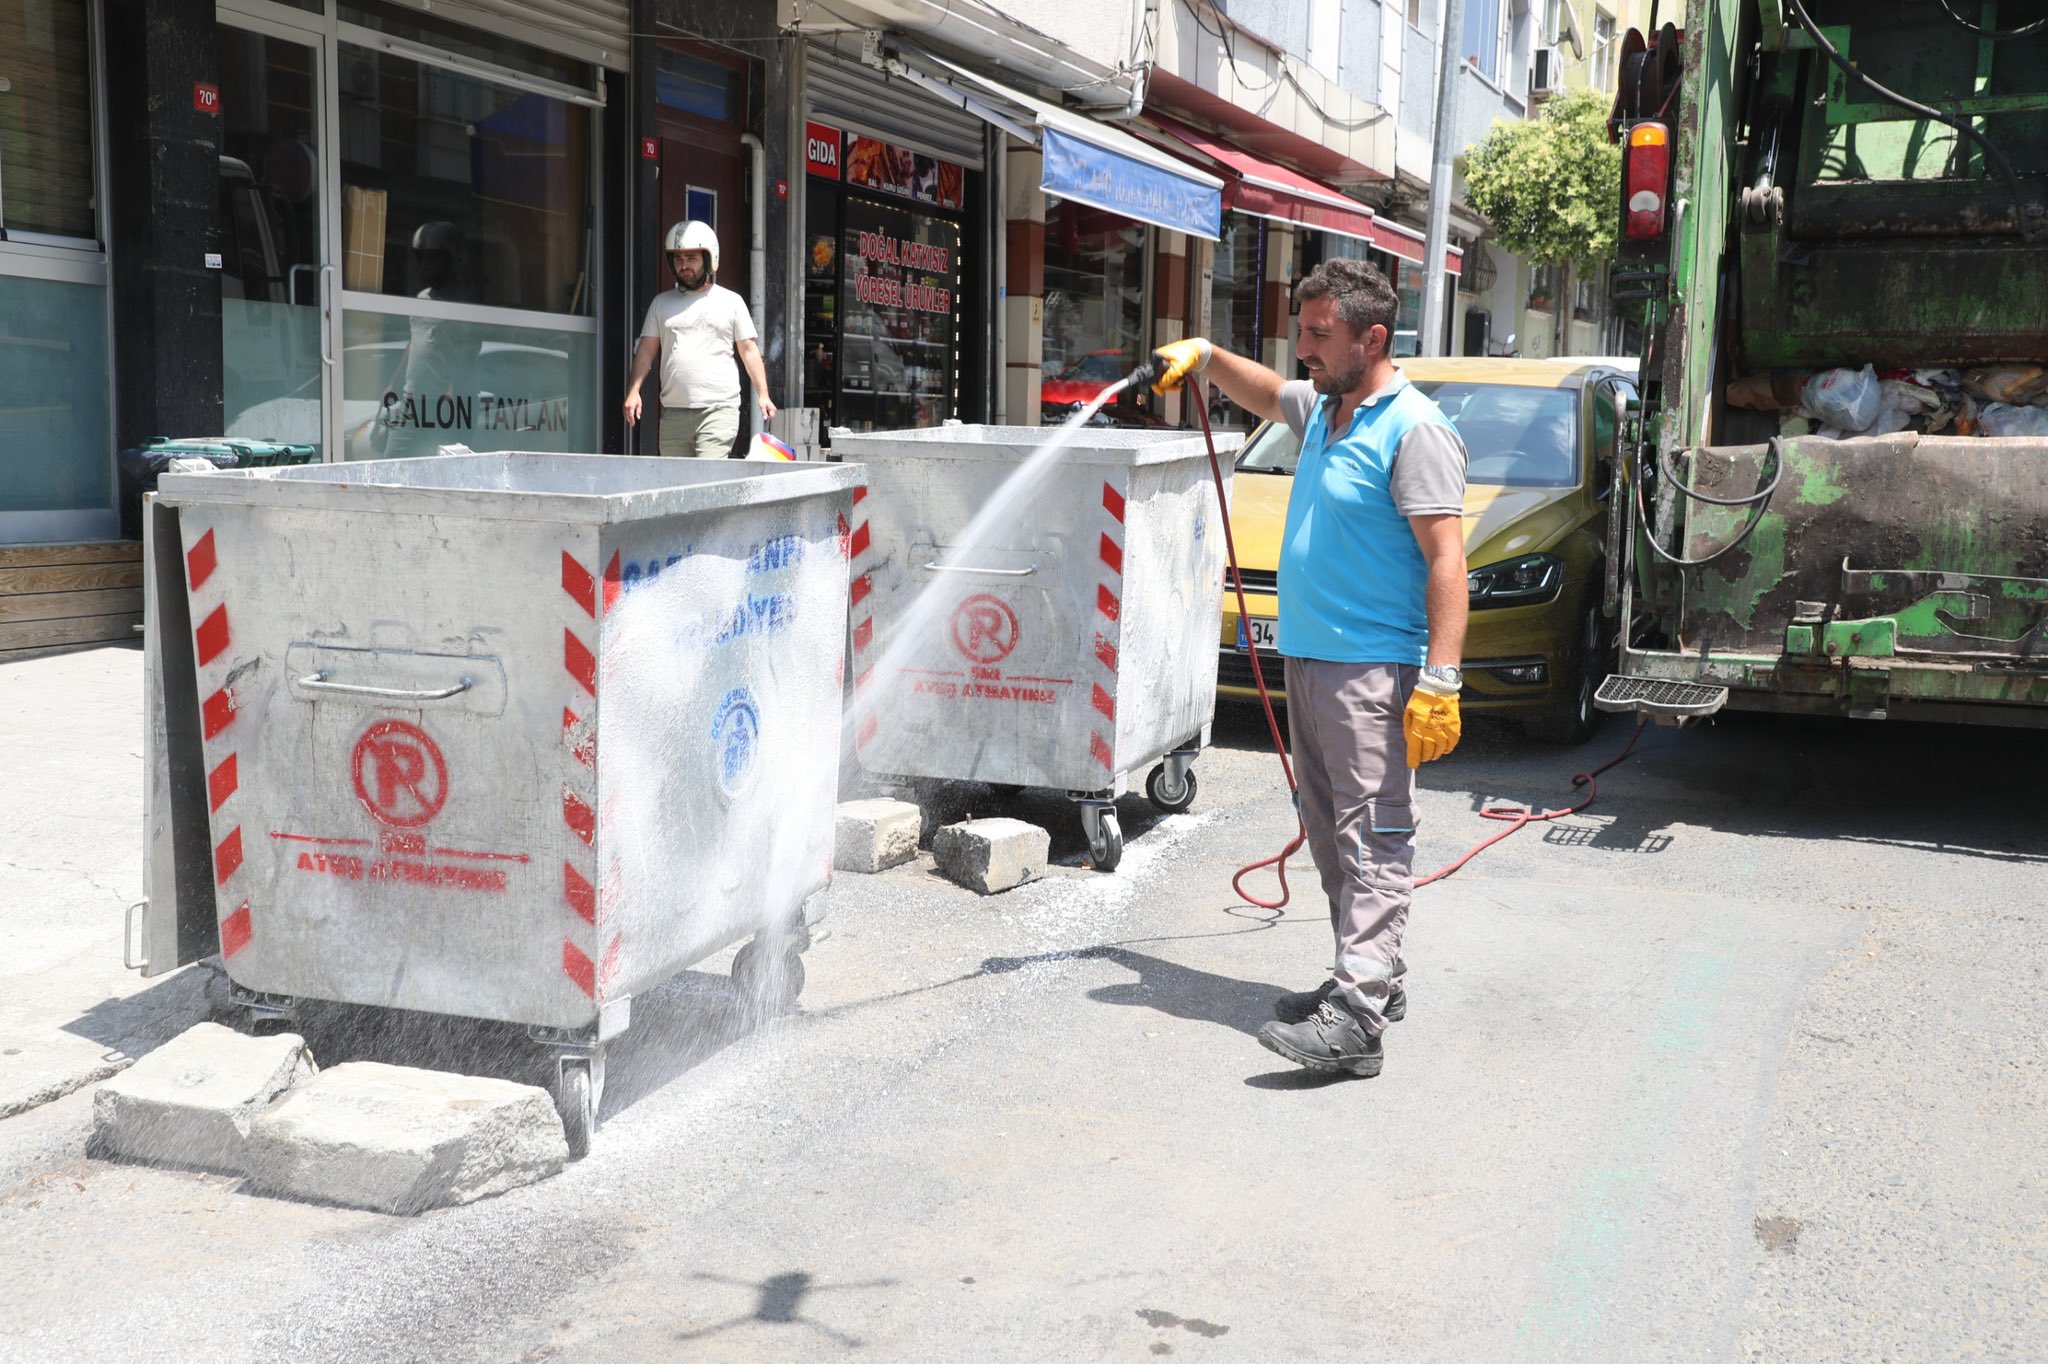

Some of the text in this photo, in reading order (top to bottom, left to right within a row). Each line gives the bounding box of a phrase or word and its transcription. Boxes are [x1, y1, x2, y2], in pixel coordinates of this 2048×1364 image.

[647, 142, 655, 154] 70
[808, 138, 836, 166] GIDA
[860, 225, 948, 274] DOĞAL KATKISIZ
[854, 266, 951, 314] YÖRESEL ÜRÜNLER
[384, 391, 567, 432] SALON TAYLAN
[1252, 622, 1274, 645] 34
